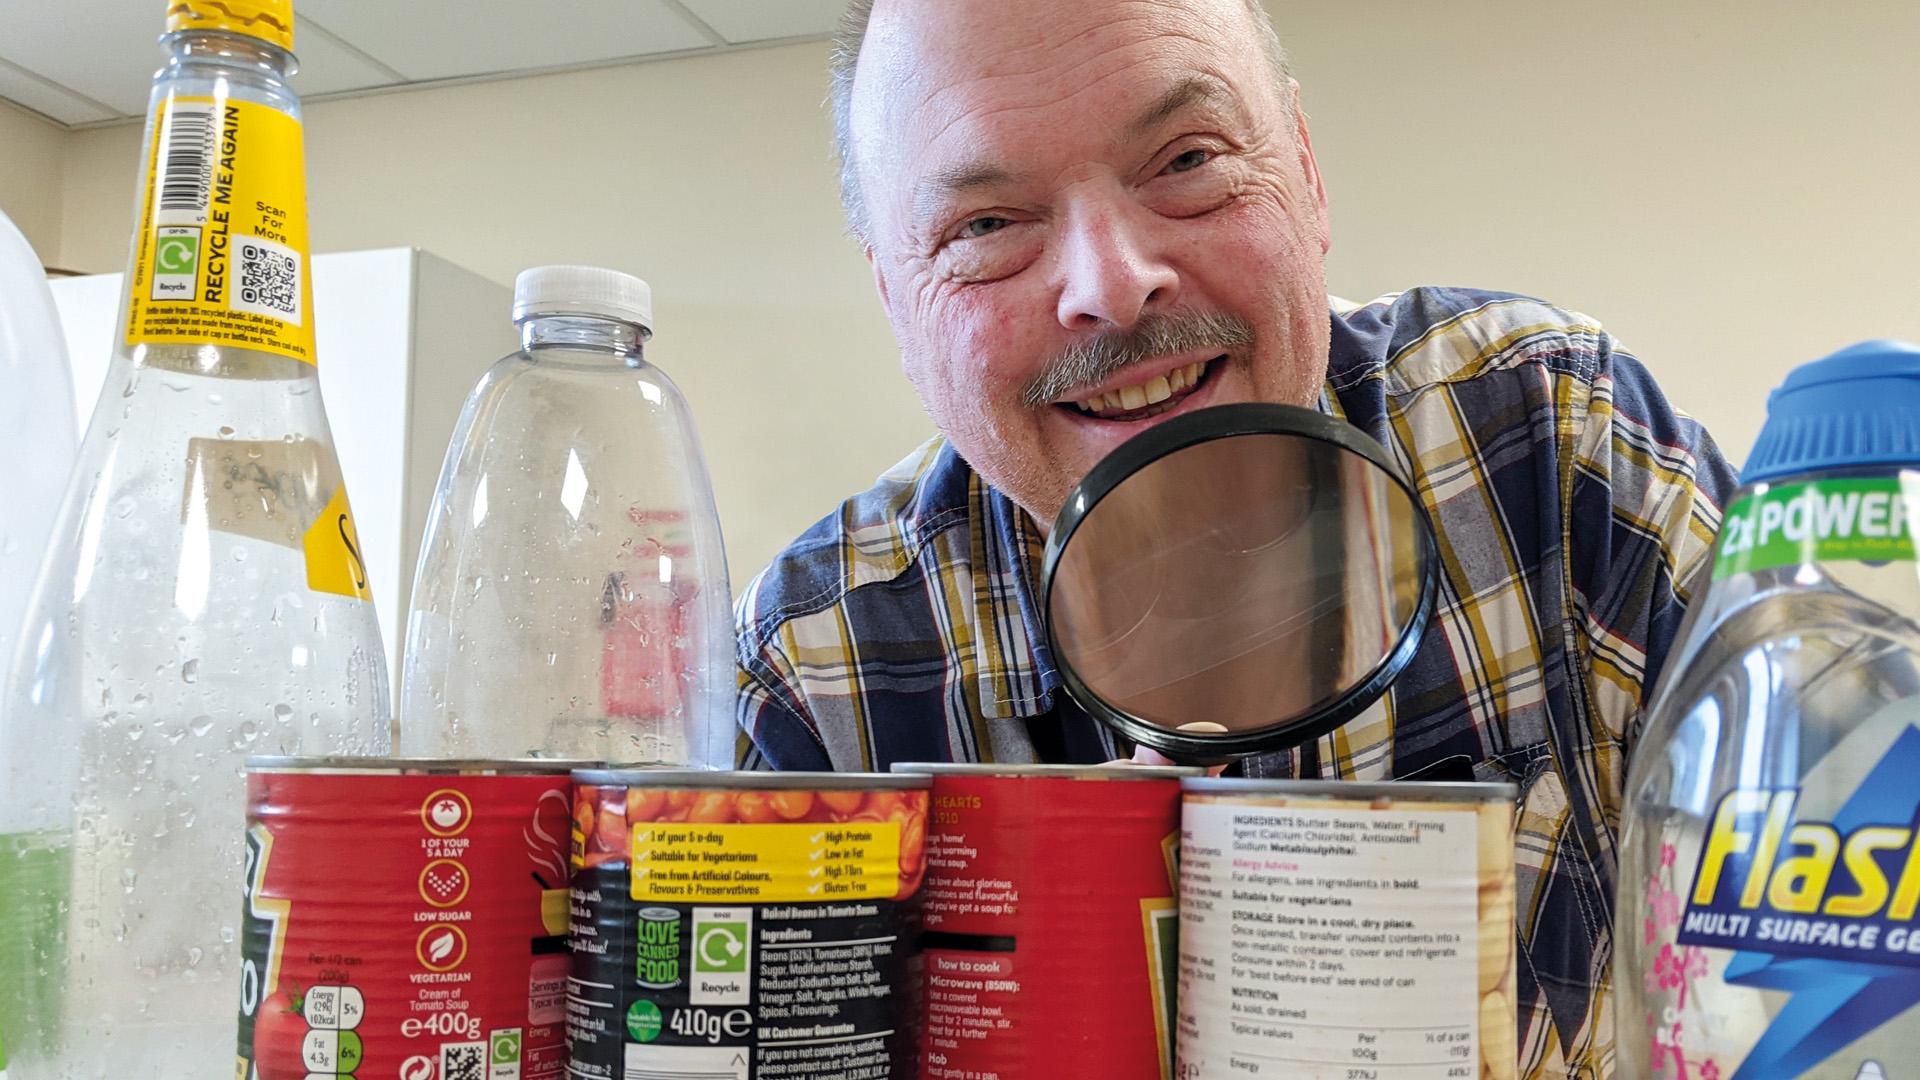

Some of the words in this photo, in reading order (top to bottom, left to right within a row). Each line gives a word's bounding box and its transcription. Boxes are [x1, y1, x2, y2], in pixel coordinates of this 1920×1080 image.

[221, 106, 240, 171] AGAIN
[215, 173, 233, 204] ME
[256, 201, 286, 219] Scan
[262, 216, 284, 230] For
[254, 226, 287, 244] More
[205, 210, 230, 302] RECYCLE
[160, 283, 186, 292] Recycle
[234, 323, 258, 334] recycled
[210, 330, 221, 340] cap
[232, 332, 248, 342] bottle
[267, 338, 281, 347] Store
[935, 796, 981, 809] HEARTS
[935, 812, 959, 824] 1910
[1233, 816, 1293, 827] INGREDIENTS
[1295, 817, 1330, 828] Butter
[1408, 820, 1446, 834] Firming
[668, 834, 688, 845] your
[825, 831, 844, 844] High
[1233, 828, 1256, 839] Agent
[428, 839, 441, 848] OF
[443, 838, 470, 848] YOUR
[1233, 840, 1268, 851] Sodium
[427, 848, 433, 857] 5
[434, 848, 442, 857] A
[444, 848, 464, 857] DAY
[651, 851, 685, 861] Suitable
[687, 851, 700, 861] for
[702, 852, 758, 864] Vegetarians
[825, 849, 842, 859] Low
[943, 847, 977, 858] warming
[1233, 859, 1261, 871] Allergy
[650, 870, 668, 880] Free
[670, 870, 690, 881] from
[692, 870, 730, 881] Artificial
[734, 871, 772, 883] Colours,
[825, 866, 844, 878] High
[649, 883, 684, 894] Flavours
[696, 884, 759, 896] Preservatives
[952, 878, 974, 887] about
[976, 878, 1012, 890] glorious
[1295, 878, 1313, 886] see
[1317, 877, 1378, 889] ingredients
[959, 889, 974, 899] and
[975, 890, 1018, 901] flavourful
[1232, 890, 1268, 902] Suitable
[1270, 892, 1284, 903] for
[761, 907, 790, 919] Baked
[791, 907, 817, 919] Beans
[826, 906, 855, 918] Tomato
[959, 902, 972, 914] got
[980, 904, 1002, 916] soup
[1003, 902, 1017, 914] for
[414, 912, 437, 922] LOW
[438, 912, 471, 921] SUGAR
[1232, 910, 1273, 922] STORAGE
[1277, 913, 1304, 925] Store
[1307, 915, 1318, 925] in
[1361, 918, 1380, 930] dry
[638, 919, 680, 944] LOVE
[761, 928, 812, 943] Ingredients
[1231, 923, 1254, 935] Once
[1299, 930, 1341, 941] transfer
[1345, 934, 1386, 943] unused
[1388, 934, 1433, 943] contents
[1436, 933, 1452, 942] into
[1684, 912, 1750, 938] MULTI
[1756, 916, 1880, 950] SURFACE
[638, 942, 679, 960] CANNED
[761, 950, 789, 962] Beans
[814, 948, 852, 960] Tomatoes
[1350, 948, 1380, 958] cover
[1384, 948, 1403, 958] and
[938, 957, 958, 970] how
[960, 960, 971, 972] to
[972, 961, 1000, 972] cook
[1232, 952, 1273, 965] Consume
[1276, 958, 1307, 968] within
[637, 957, 679, 983] FOOD
[789, 962, 825, 975] Modified
[410, 973, 471, 984] VEGETARIAN
[760, 978, 798, 989] Reduced
[800, 977, 830, 988] Sodium
[930, 975, 983, 990] Microwave
[1232, 966, 1244, 977] For
[1273, 972, 1307, 983] before
[1337, 978, 1356, 986] see
[1359, 976, 1380, 986] end
[1382, 976, 1394, 986] of
[1396, 979, 1416, 988] can
[312, 989, 334, 1002] Energy
[419, 988, 449, 1000] Cream
[451, 988, 461, 998] of
[701, 982, 740, 996] Recycle
[1232, 986, 1278, 1001] NUTRITION
[948, 992, 976, 1003] covered
[344, 1003, 358, 1015] 5%
[410, 1000, 444, 1011] Tomato
[446, 1000, 469, 1010] Soup
[1267, 1007, 1306, 1019] drained
[758, 1027, 771, 1040] UK
[772, 1027, 814, 1039] Customer
[814, 1023, 855, 1036] Guarantee
[962, 1027, 988, 1039] further
[1231, 1022, 1260, 1034] Typical
[1262, 1028, 1293, 1039] values
[1358, 1033, 1377, 1043] Per
[314, 1038, 325, 1048] Fat
[341, 1047, 356, 1059] 6%
[765, 1050, 782, 1063] you
[783, 1052, 798, 1062] are
[799, 1047, 814, 1058] not
[814, 1042, 856, 1058] completely
[928, 1052, 947, 1065] Hob
[1352, 1048, 1377, 1060] 100g
[310, 1052, 329, 1067] 4.3g
[757, 1063, 786, 1076] please
[788, 1061, 820, 1072] contact
[842, 1056, 875, 1067] Customer
[1230, 1057, 1259, 1072] Energy
